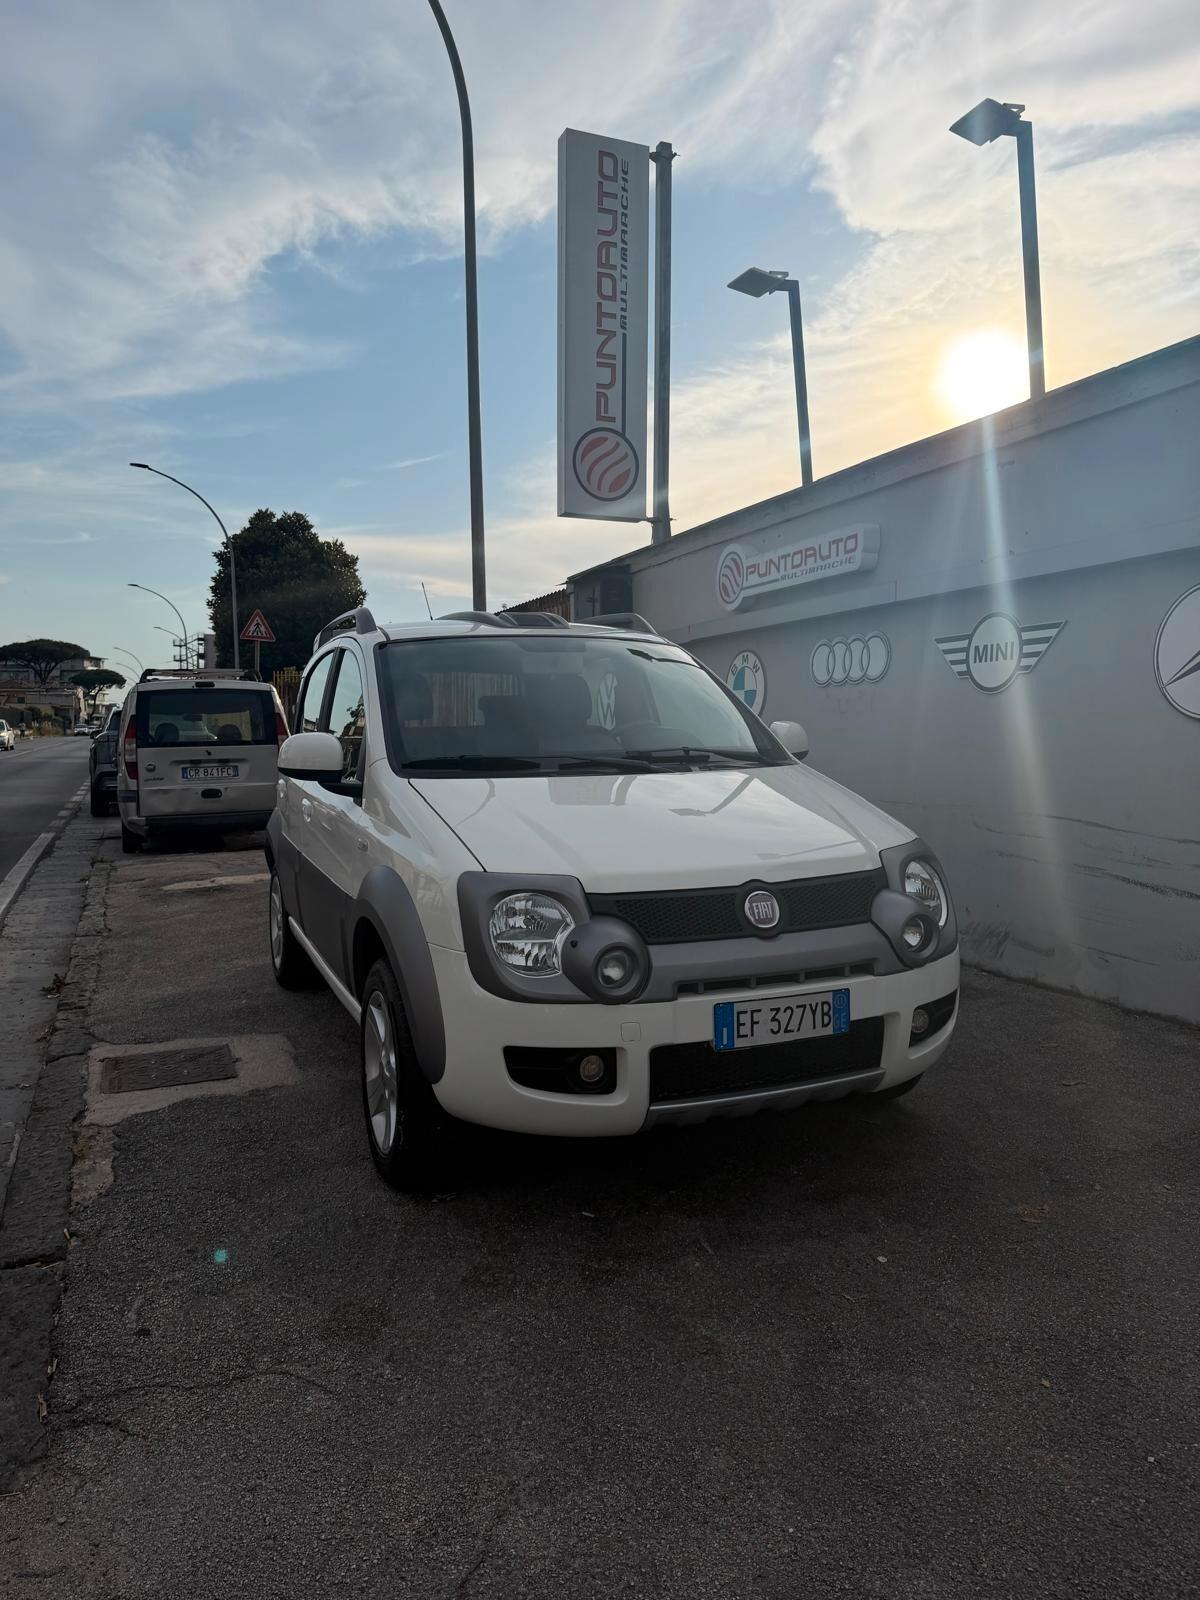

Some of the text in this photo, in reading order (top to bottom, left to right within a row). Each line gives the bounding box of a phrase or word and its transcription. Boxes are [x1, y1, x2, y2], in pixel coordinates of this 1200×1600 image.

[618, 158, 629, 332] MULTIMARCHE
[595, 149, 619, 423] PUNTOAUTO
[745, 532, 858, 582] PUNTOAUTO
[779, 556, 857, 582] MULTIMARCHE
[730, 653, 761, 677] BMW
[973, 641, 1015, 664] MINI
[188, 767, 232, 778] CR 841FC
[752, 901, 774, 920] FIAT
[736, 1009, 762, 1039] EF
[769, 1001, 832, 1035] 327YB
